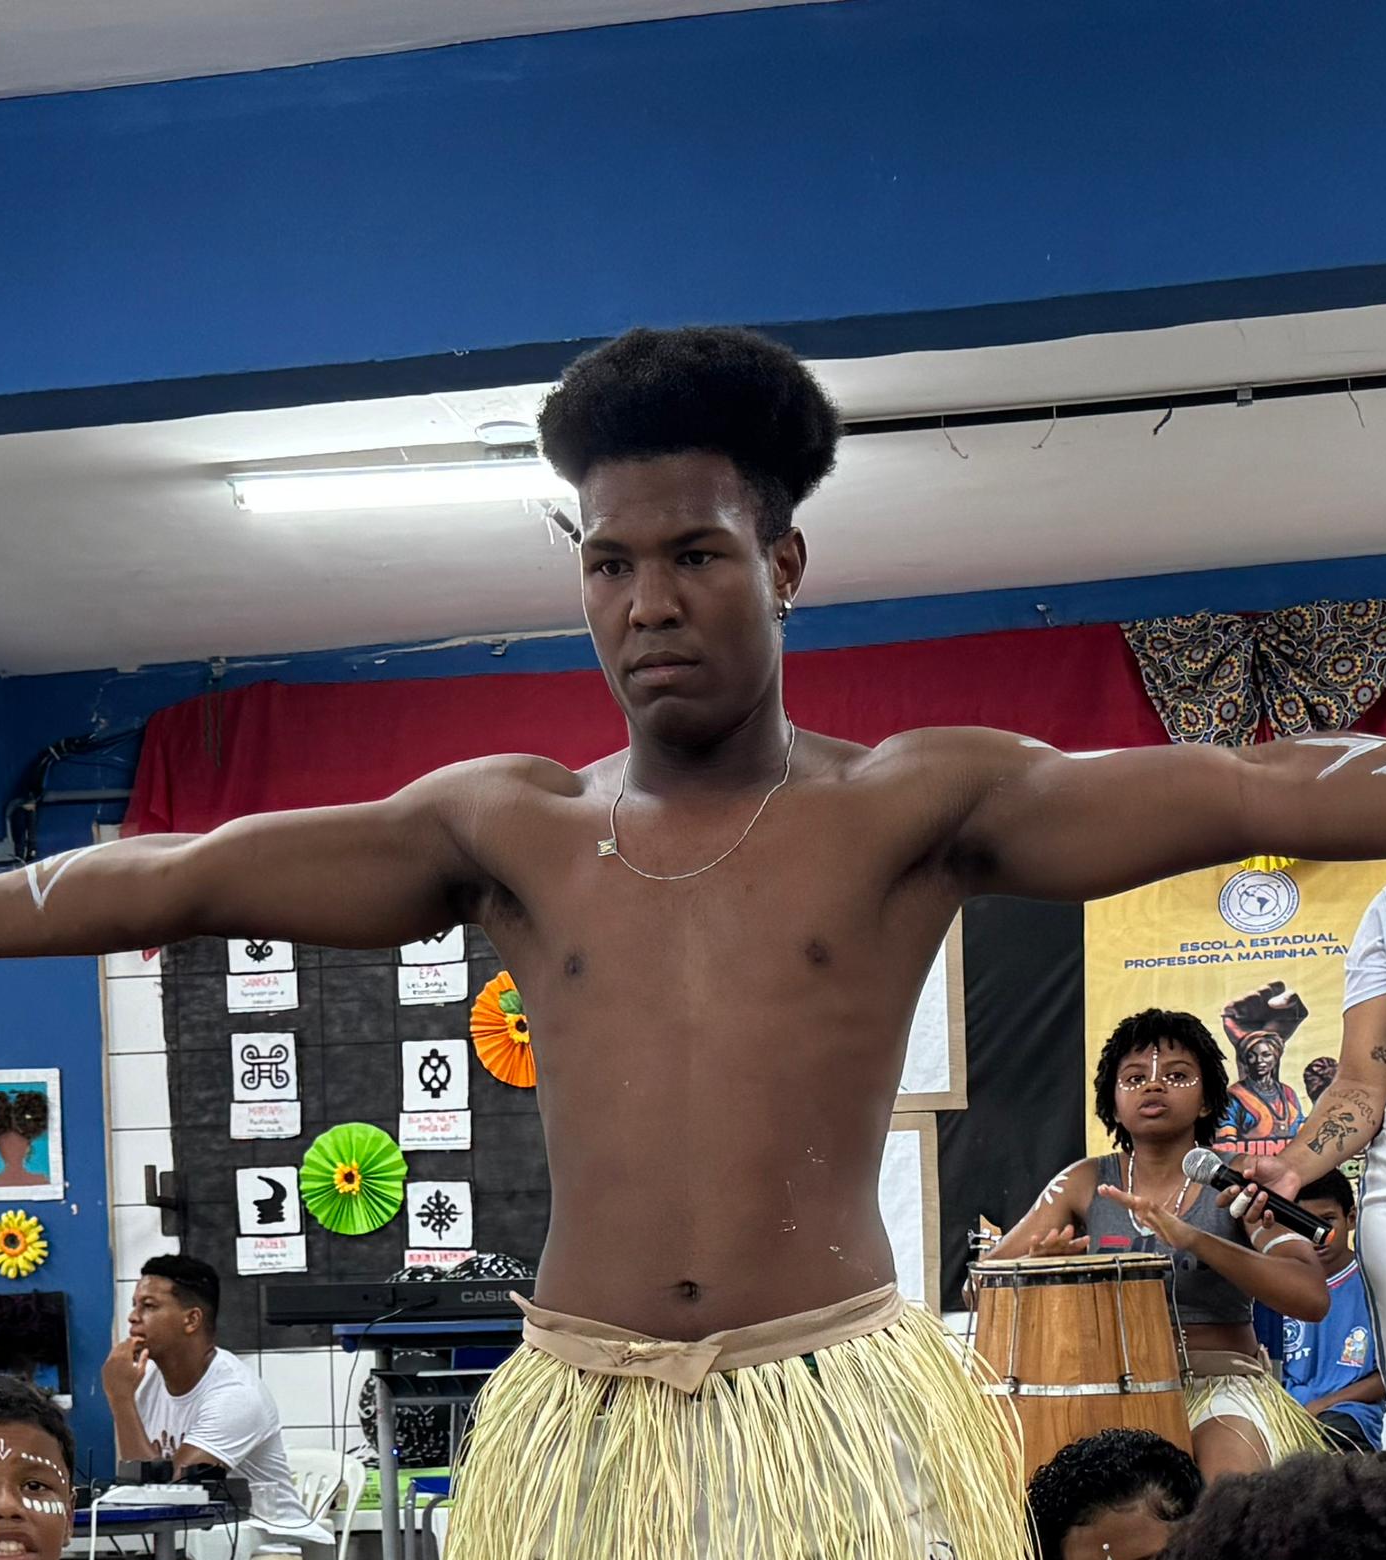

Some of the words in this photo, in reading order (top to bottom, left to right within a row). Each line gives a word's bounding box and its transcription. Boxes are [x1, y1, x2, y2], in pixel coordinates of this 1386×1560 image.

[1180, 938, 1246, 953] ESCOLA
[1249, 932, 1339, 948] ESTADUAL
[1124, 952, 1234, 969] PROFESSORA
[1321, 945, 1351, 956] TAV
